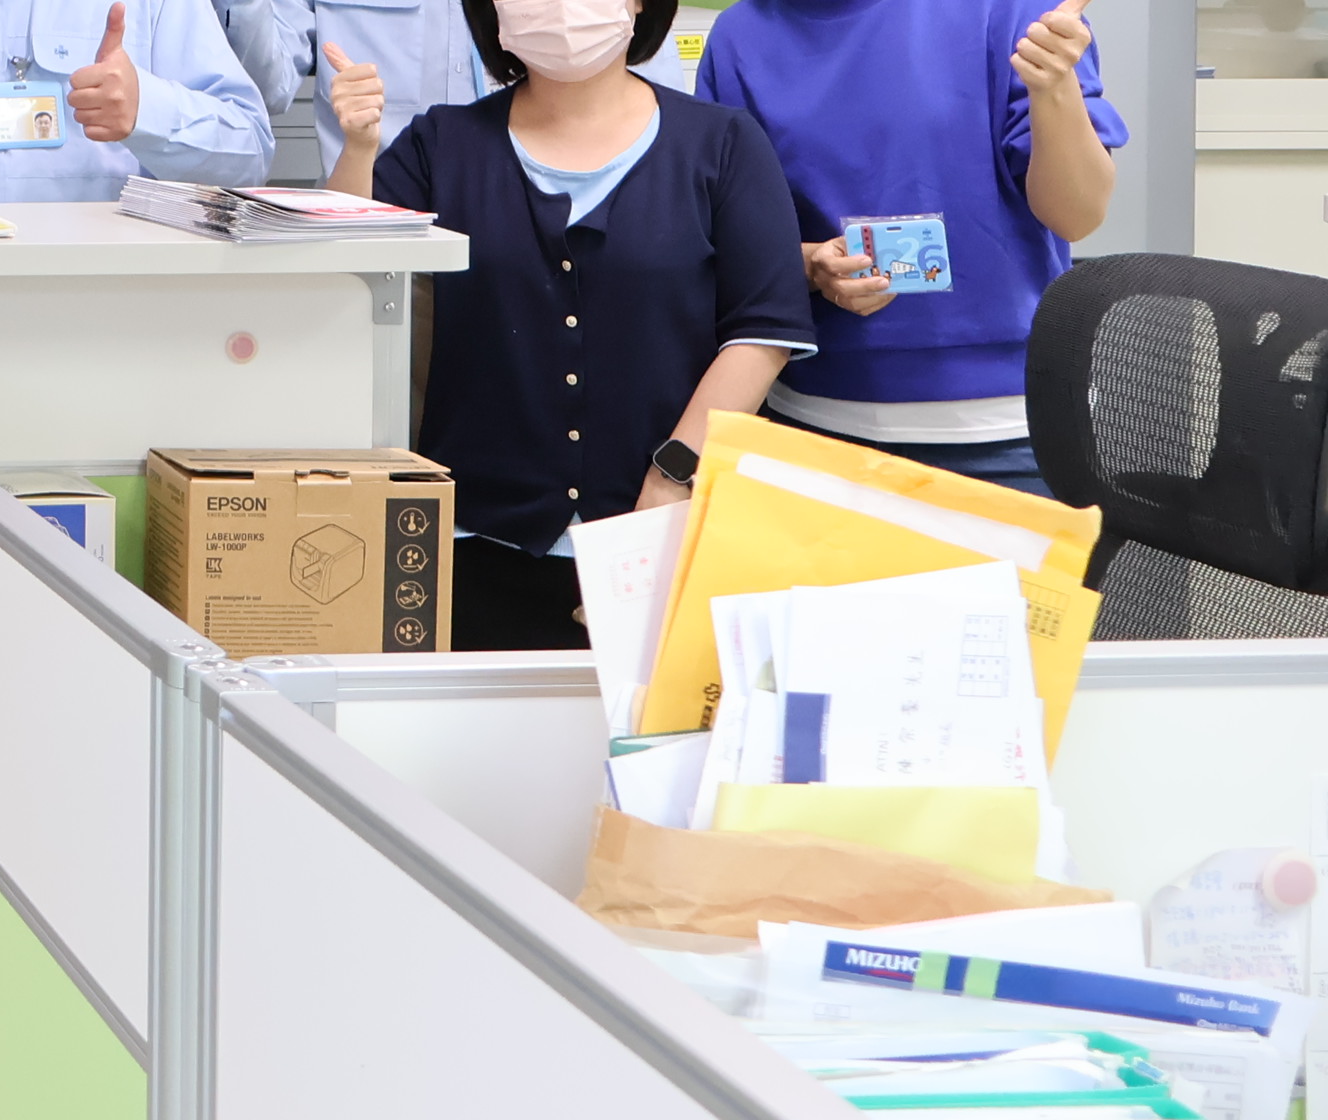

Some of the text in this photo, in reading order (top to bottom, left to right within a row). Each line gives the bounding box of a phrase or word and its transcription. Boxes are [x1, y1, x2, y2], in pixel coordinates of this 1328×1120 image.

[207, 496, 267, 512] EPSON
[206, 532, 265, 541] LABELWORKS
[206, 543, 247, 551] LW-1000P
[1176, 991, 1261, 1014] Mizuho Bank
